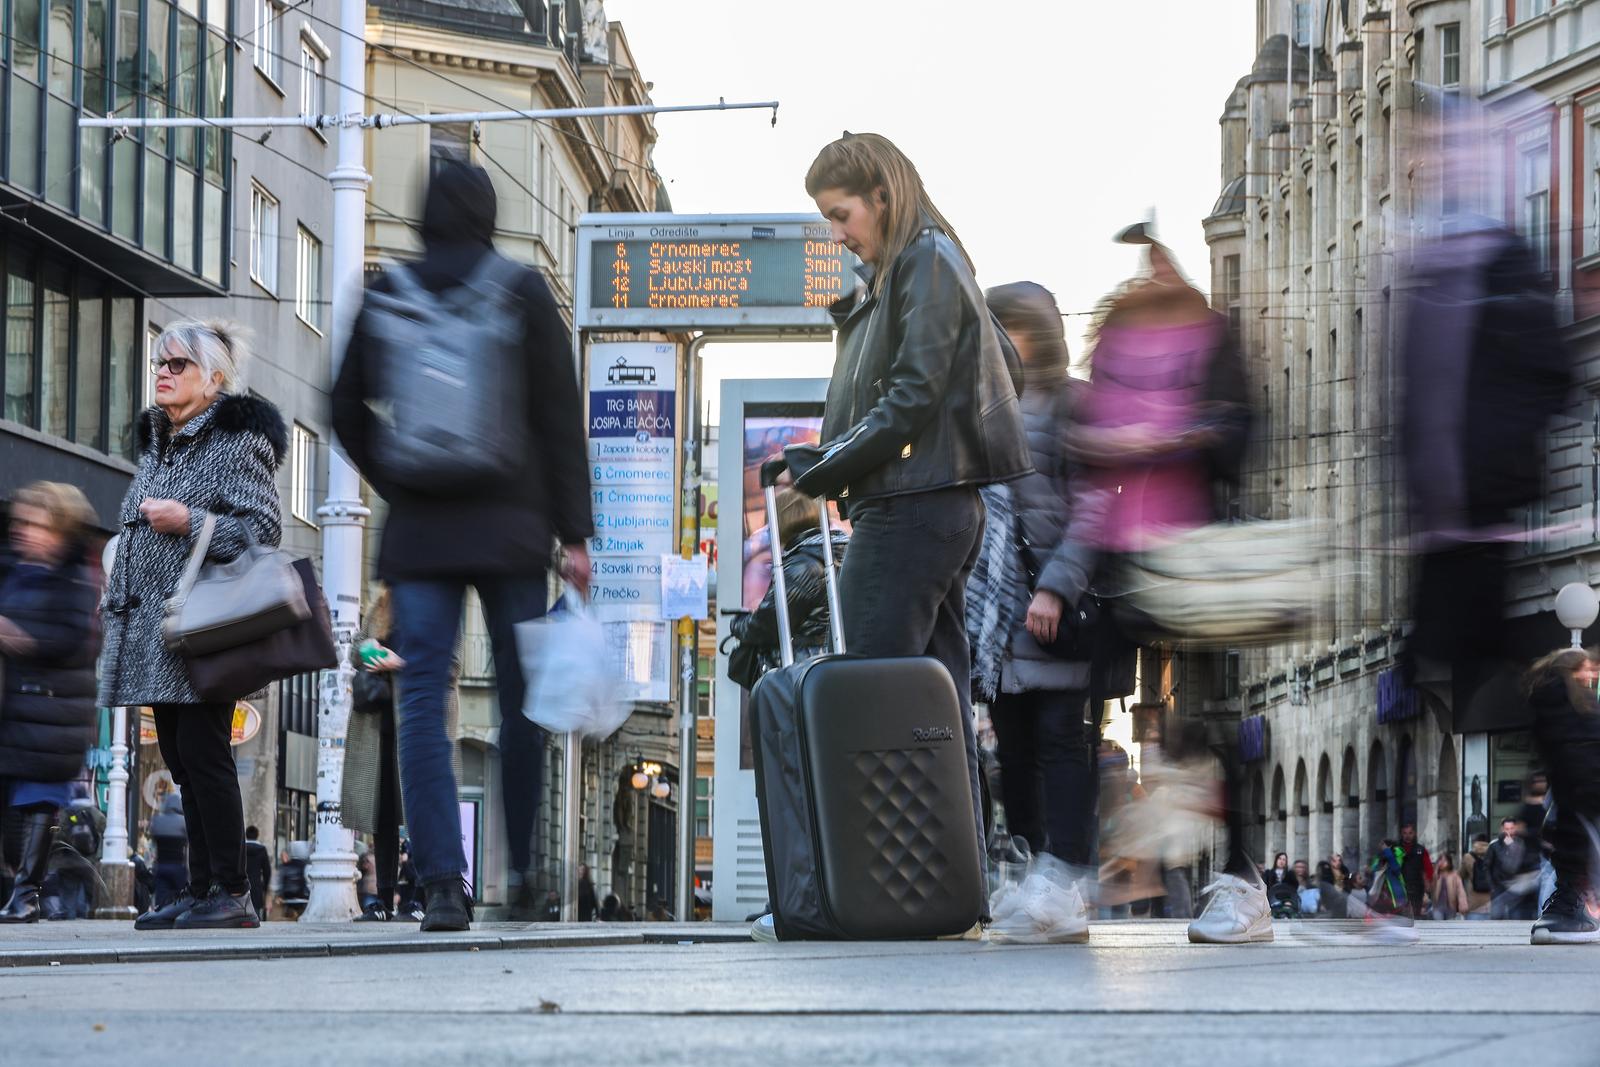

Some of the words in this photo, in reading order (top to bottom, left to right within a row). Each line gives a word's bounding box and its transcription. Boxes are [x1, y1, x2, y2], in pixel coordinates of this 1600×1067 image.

[608, 229, 635, 240] Linija
[650, 228, 699, 238] Odredište
[612, 259, 630, 274] 14
[650, 259, 707, 274] Savski
[711, 259, 752, 273] most
[805, 257, 842, 272] 3min
[612, 276, 630, 291] 12
[649, 276, 748, 291] Ljubljanica
[805, 274, 842, 290] 3min
[612, 293, 628, 308] 11
[607, 399, 624, 411] TRG
[627, 399, 654, 410] BANA
[591, 417, 620, 429] JOSIPA
[623, 415, 671, 429] JELAČIĆA
[596, 443, 600, 456] 1
[603, 444, 635, 454] Zapadni
[594, 466, 602, 480] 6
[606, 465, 671, 480] Črnomerec
[592, 491, 603, 505] 11
[608, 490, 672, 503] Črnomerec
[608, 514, 669, 528] Ljubljanica
[591, 537, 603, 551] 13
[606, 536, 644, 552] Žitnjak
[601, 562, 634, 574] Savski
[636, 564, 662, 575] mos
[602, 587, 640, 599] Prečko
